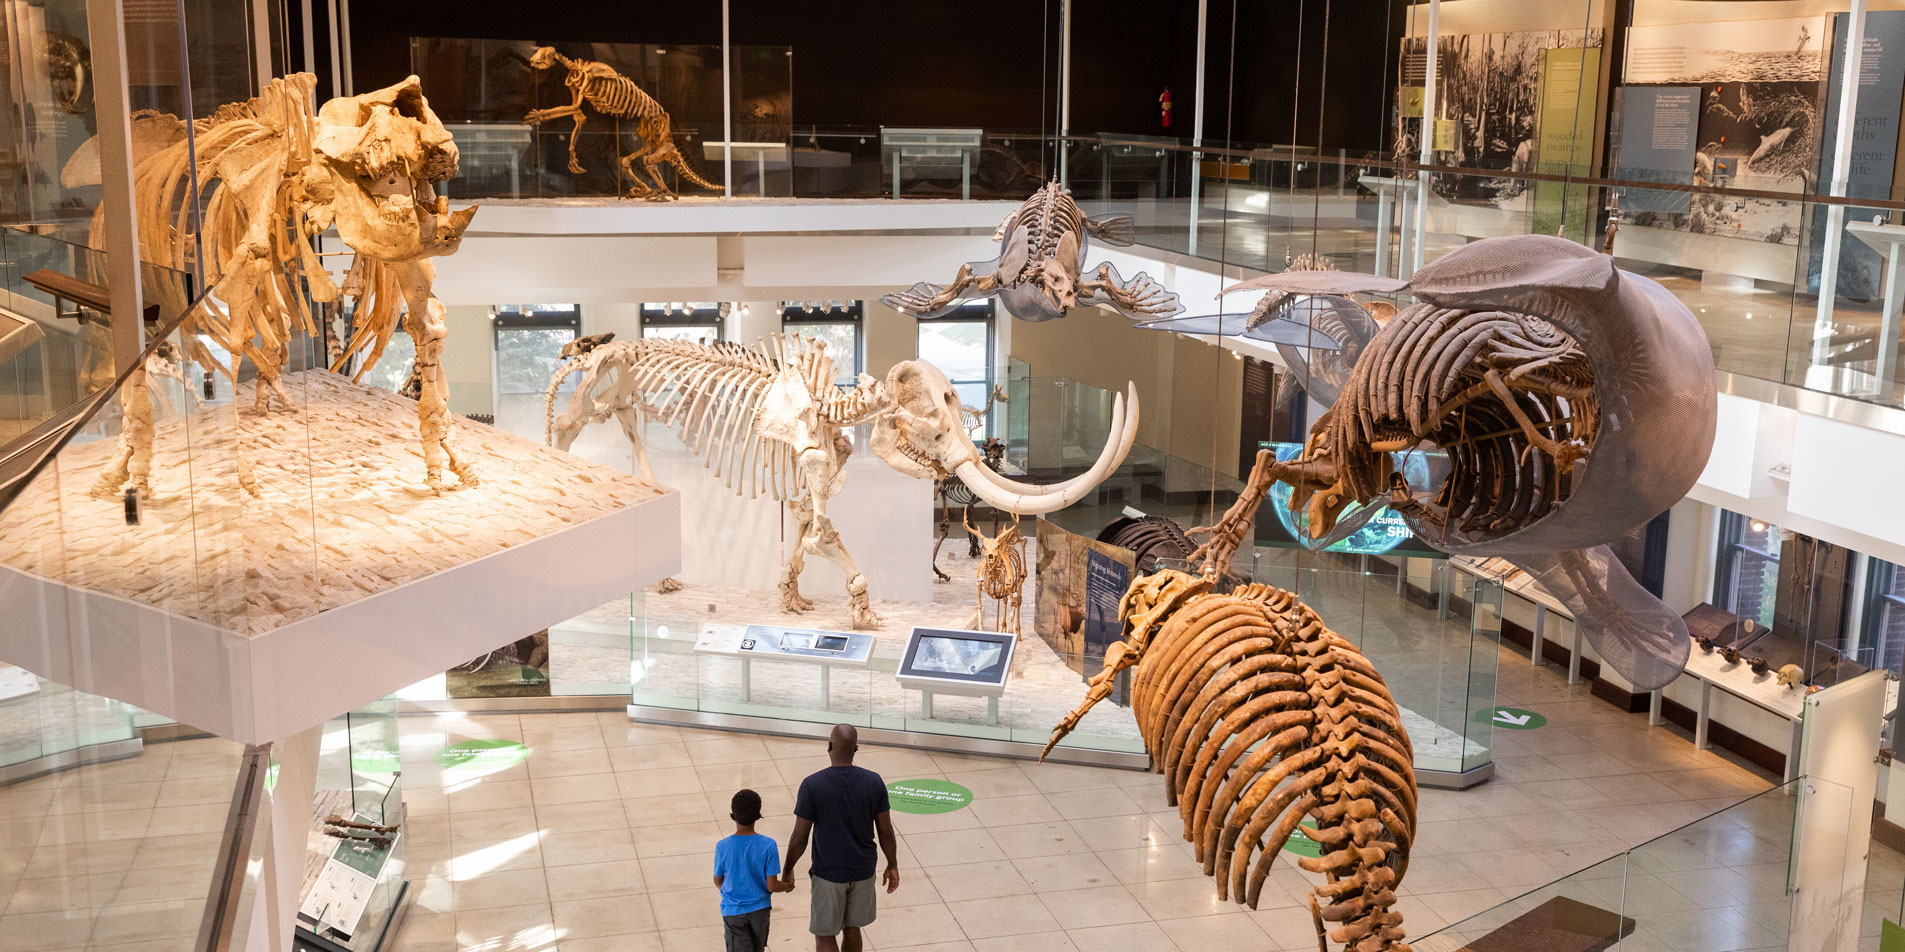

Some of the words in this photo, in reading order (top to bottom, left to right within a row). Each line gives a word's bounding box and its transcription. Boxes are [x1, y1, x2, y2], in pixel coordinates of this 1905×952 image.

[1834, 112, 1888, 126] erent
[1546, 130, 1583, 141] woodd
[1833, 127, 1876, 141] ths
[1831, 146, 1885, 161] erent
[1544, 156, 1580, 168] tropal
[1851, 161, 1871, 175] life
[1376, 517, 1407, 526] CURRE
[905, 791, 935, 799] family
[935, 794, 965, 802] group
[916, 788, 949, 796] person
